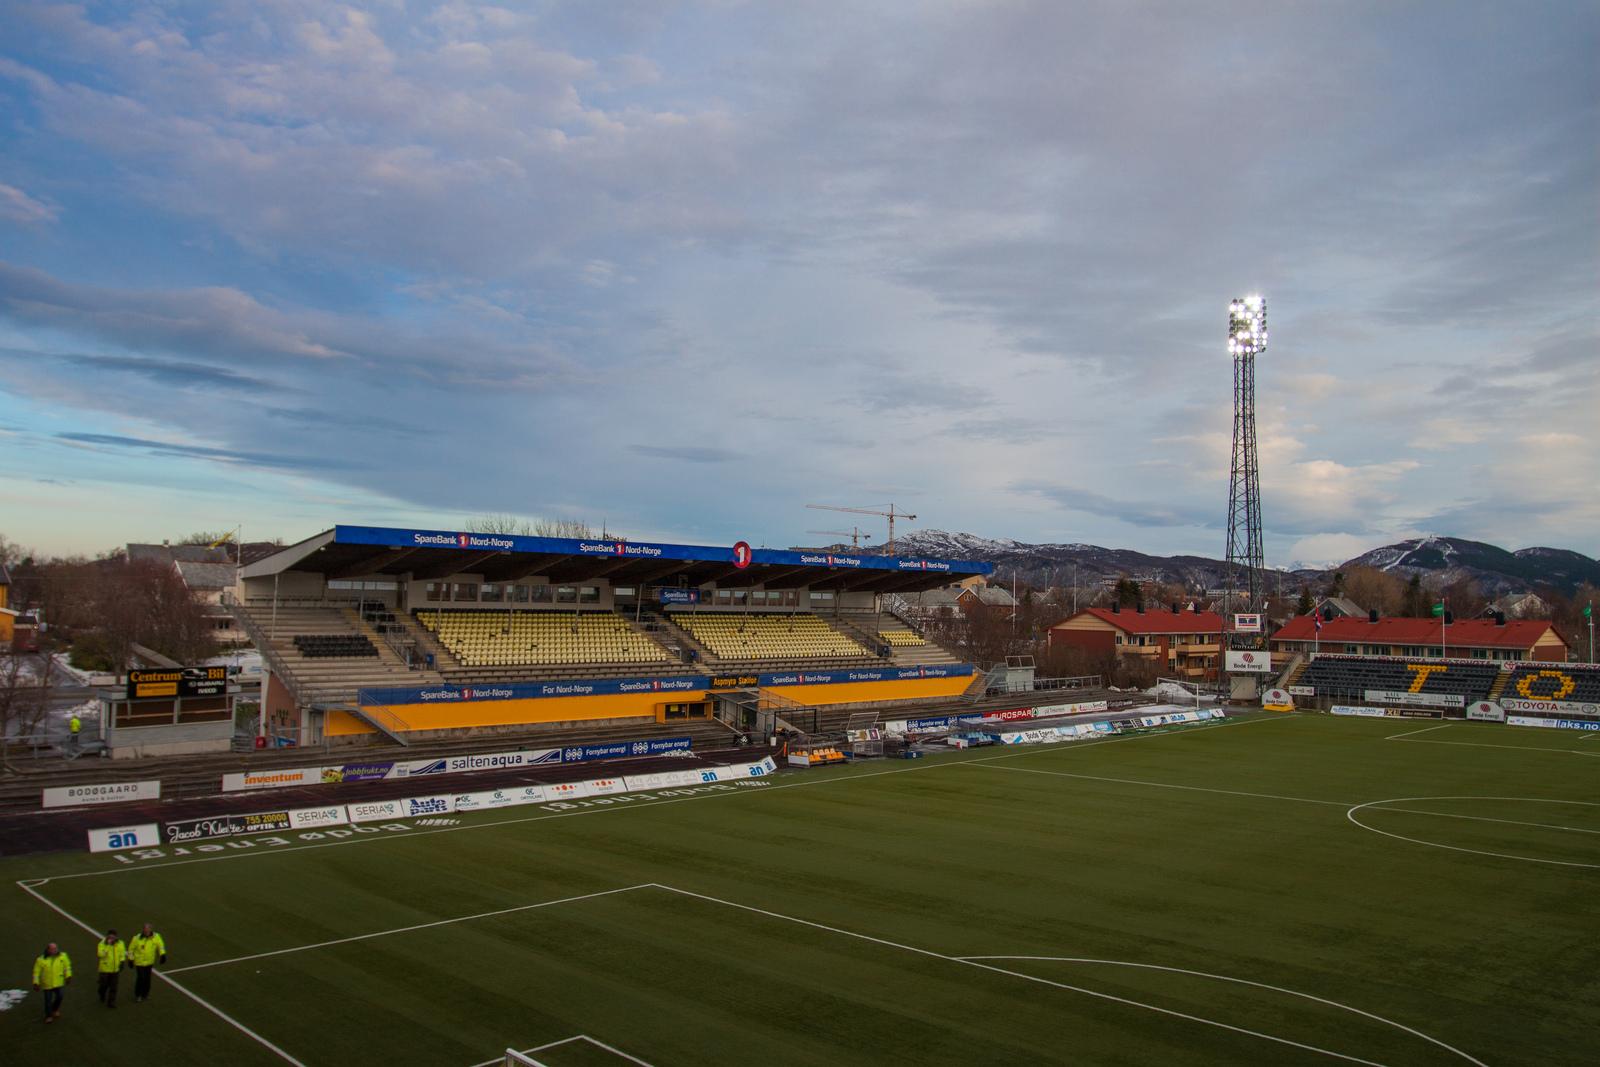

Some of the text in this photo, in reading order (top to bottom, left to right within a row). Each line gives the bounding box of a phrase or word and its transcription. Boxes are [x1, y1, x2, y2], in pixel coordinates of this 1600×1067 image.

[414, 533, 457, 545] SpareBank
[470, 537, 513, 548] Nord-Norge
[580, 543, 615, 553] SpareBank
[625, 546, 662, 556] Nord-Norge
[800, 555, 826, 564] SpareBank
[833, 557, 861, 567] Nord-Norge
[899, 560, 921, 569] SpareBank
[927, 562, 950, 571] Nord-Norge
[130, 668, 225, 683] Centrum Bil
[772, 676, 797, 684] SpareBank
[804, 674, 832, 683] Nord-Norge
[849, 671, 882, 680] For Nord-Norge
[542, 684, 593, 694] For Nord-Norge
[619, 681, 651, 691] SpareBank
[660, 680, 693, 690] Nord-Norge
[421, 690, 460, 700] SpareBank
[472, 688, 513, 698] Nord-Norge
[1515, 701, 1559, 711] TOYOTA
[609, 745, 626, 755] energi
[651, 739, 689, 750] Fornybar energi
[451, 754, 523, 771] saltenaqua
[701, 771, 718, 782] an
[748, 766, 765, 776] an
[245, 771, 304, 784] inventum
[68, 784, 138, 797] BODØGAARD
[410, 798, 446, 809] Auto
[296, 811, 330, 821] SERIA
[355, 805, 386, 816] SERIA
[410, 806, 448, 816] Parts
[244, 815, 261, 825] 755
[262, 812, 287, 824] 20000
[247, 822, 276, 832] OPTIK
[277, 820, 289, 829] AS
[167, 823, 202, 842] Jacob
[108, 831, 138, 849] an
